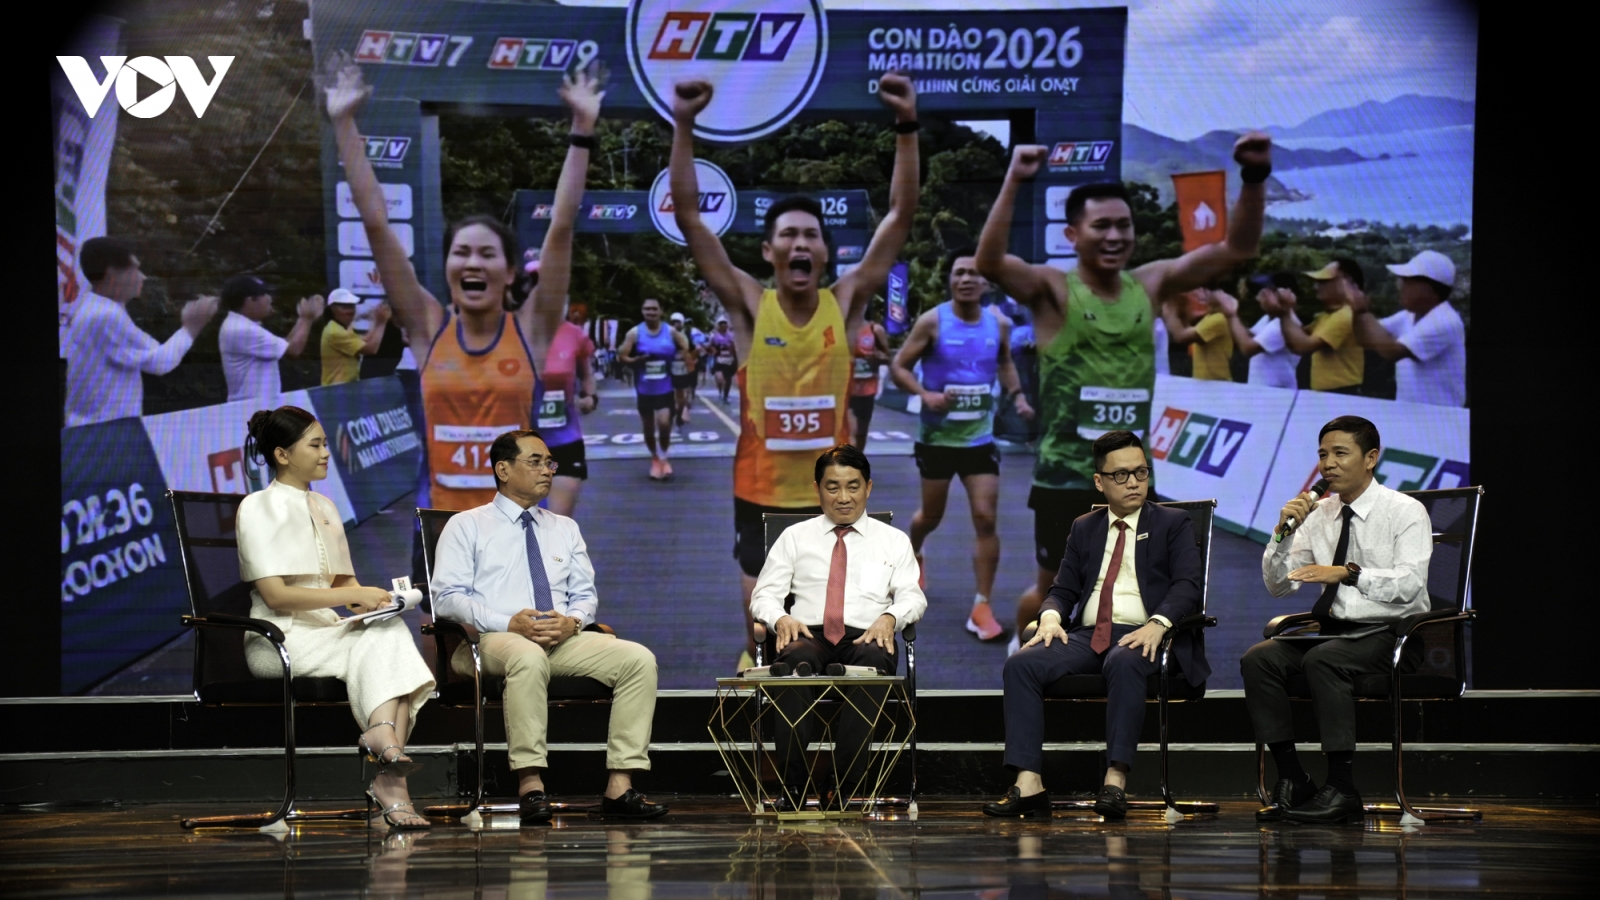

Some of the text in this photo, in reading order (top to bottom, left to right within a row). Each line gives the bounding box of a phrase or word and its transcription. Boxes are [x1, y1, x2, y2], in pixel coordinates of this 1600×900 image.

[355, 30, 473, 67] HTV7
[488, 37, 599, 71] HTV9
[650, 13, 804, 60] HTV
[868, 28, 922, 50] CON
[983, 26, 1084, 69] 2026
[1048, 141, 1114, 165] HTV
[779, 412, 820, 433] 395
[1093, 404, 1137, 424] 306
[1151, 406, 1252, 477] HTV
